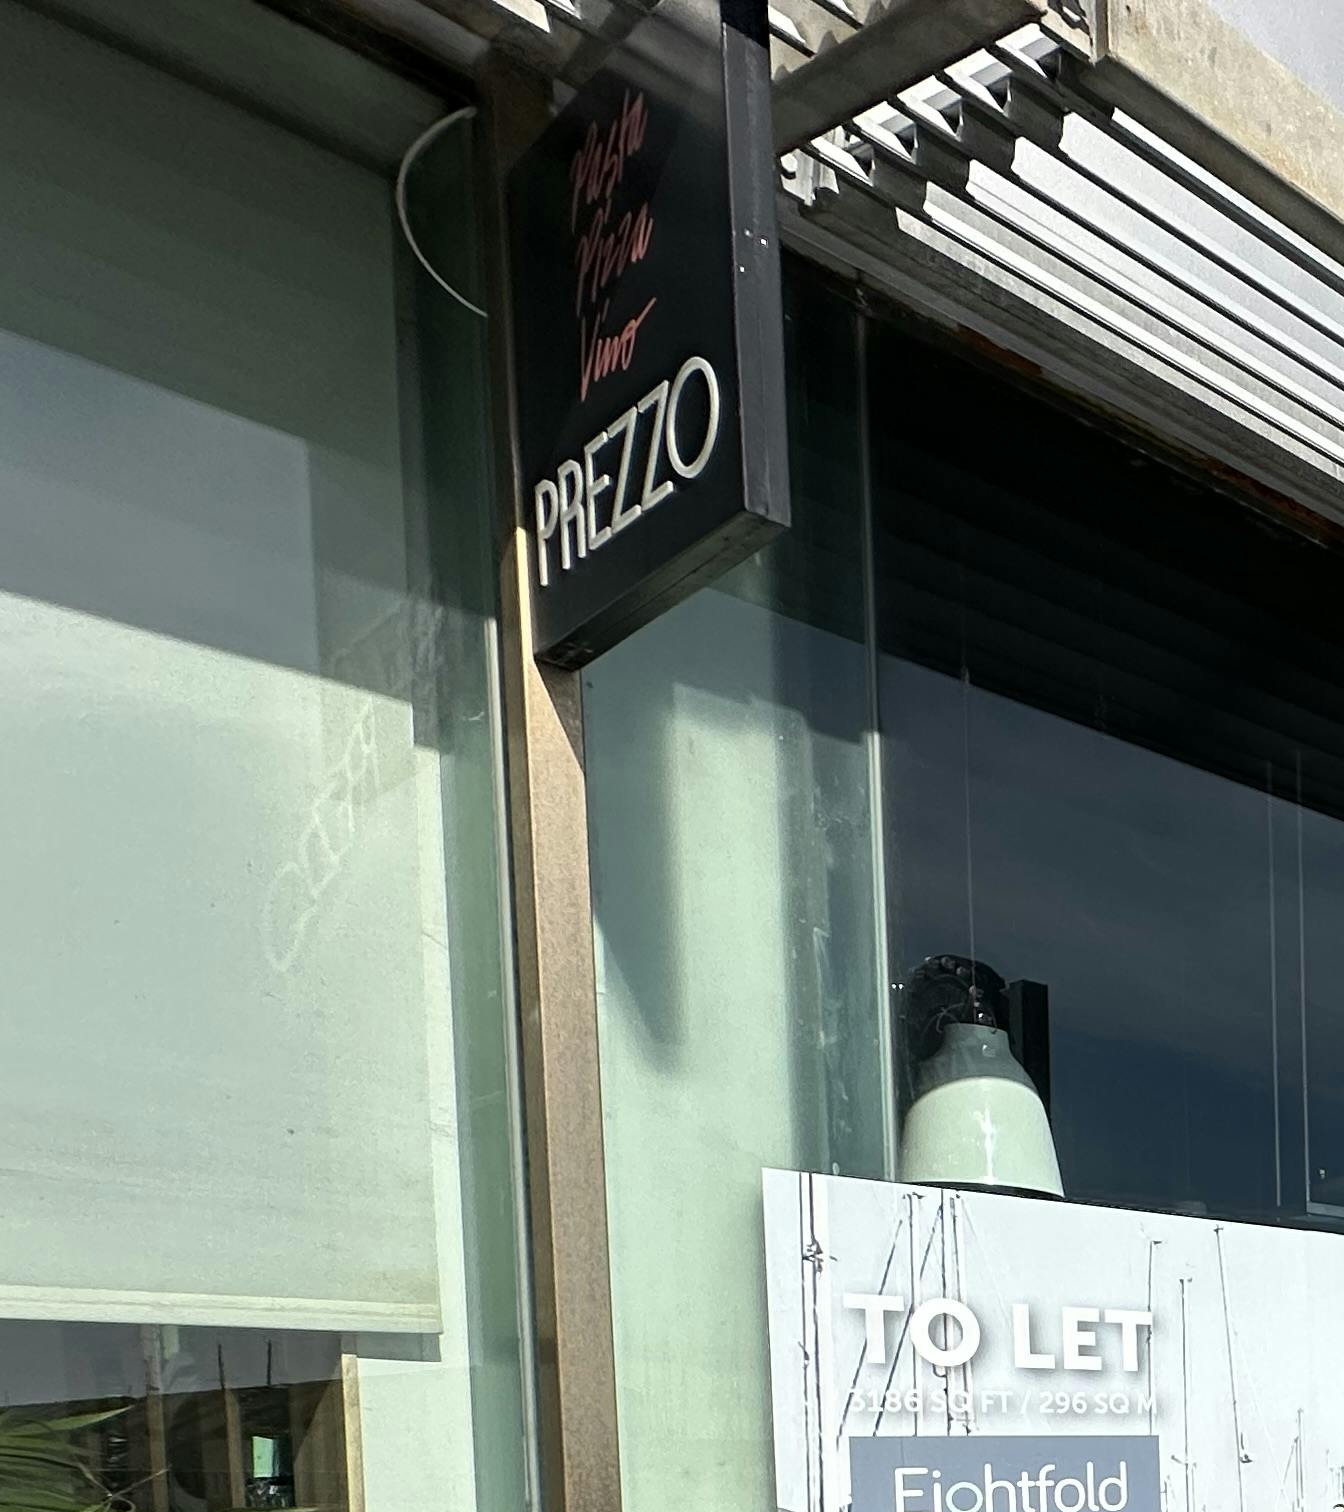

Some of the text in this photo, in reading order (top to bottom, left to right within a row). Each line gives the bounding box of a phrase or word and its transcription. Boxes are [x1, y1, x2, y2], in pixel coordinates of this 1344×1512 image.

[578, 297, 656, 402] Vino
[535, 356, 720, 586] PREZZO
[843, 1293, 1153, 1372] TO LET
[931, 1390, 973, 1414] SQ
[981, 1391, 1013, 1413] FT
[1039, 1391, 1087, 1414] 296
[1094, 1392, 1130, 1414] SQ
